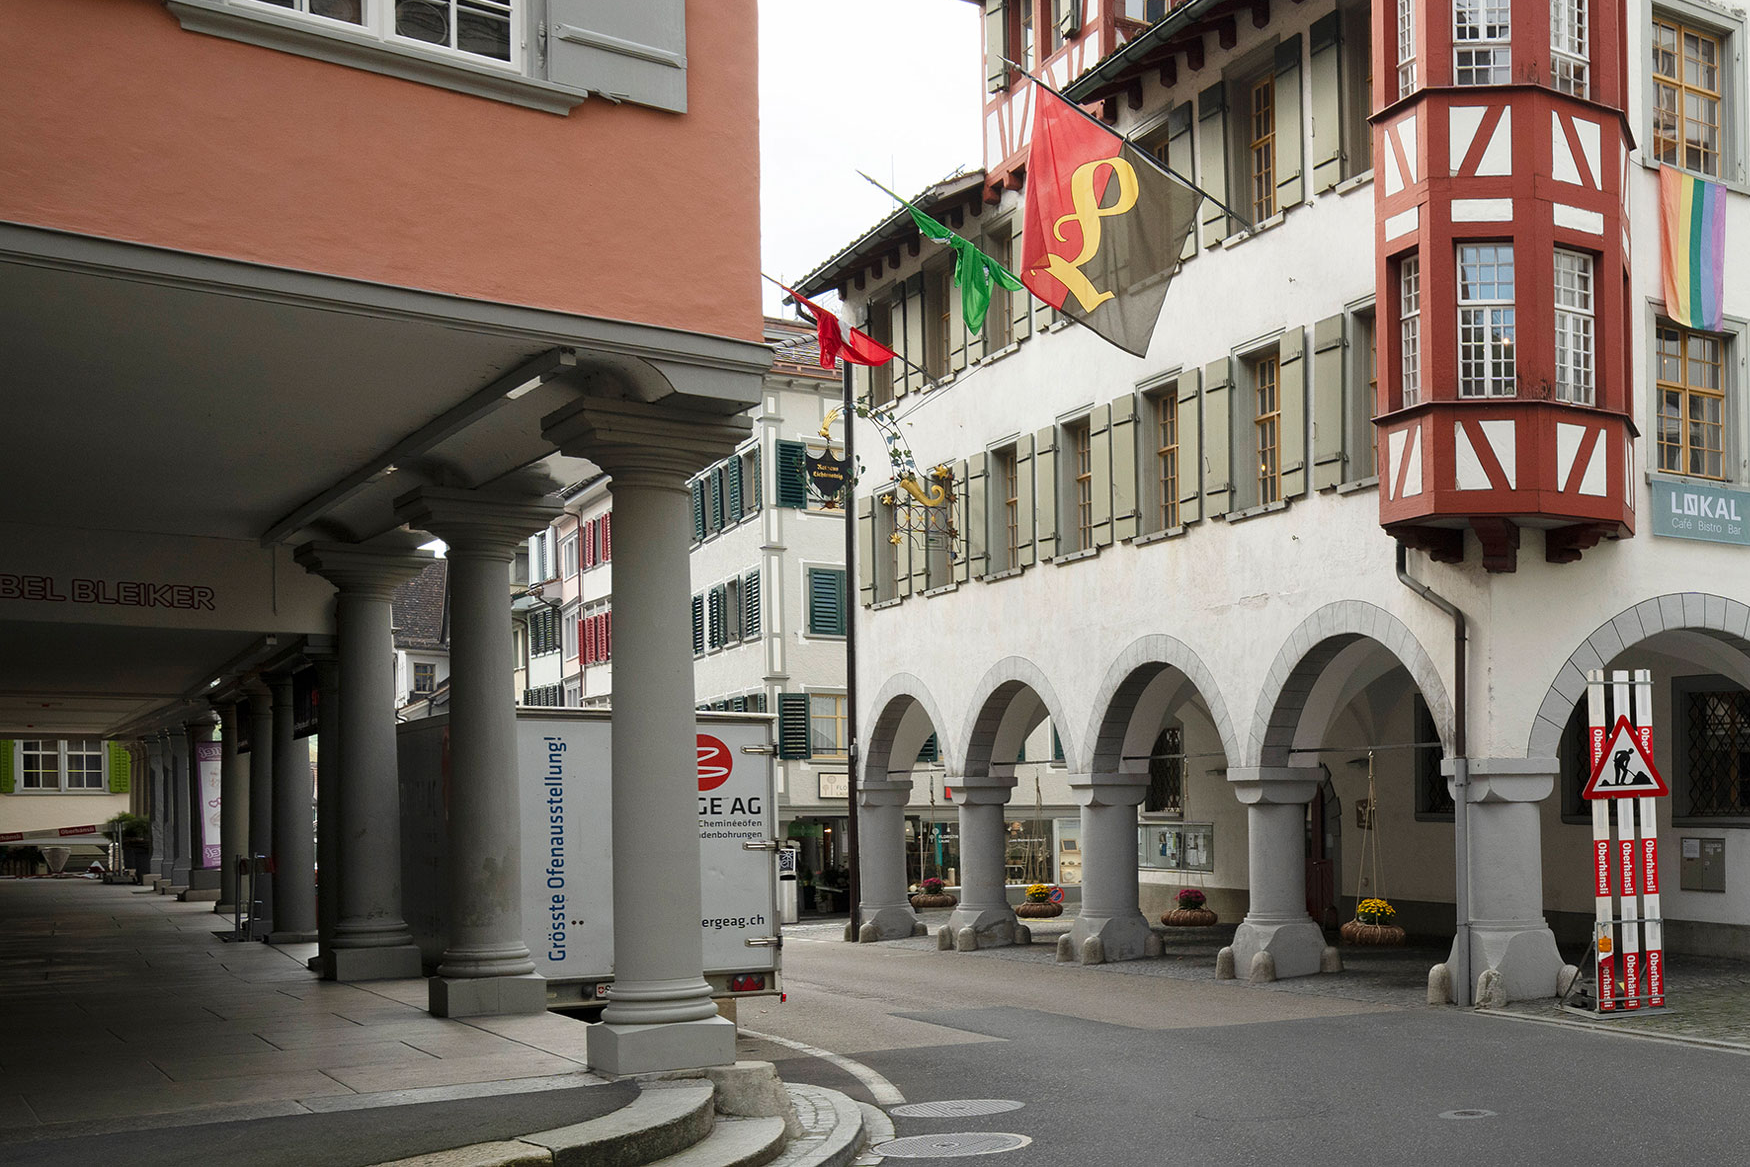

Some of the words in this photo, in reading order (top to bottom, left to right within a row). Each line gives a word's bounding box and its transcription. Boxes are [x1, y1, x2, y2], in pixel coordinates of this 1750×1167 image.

[1671, 517, 1692, 530] Café
[1698, 520, 1722, 533] Bistro
[1728, 523, 1742, 535] Bar
[71, 578, 216, 611] BLEIKER
[543, 736, 567, 889] Ofenausstellung!
[730, 797, 761, 815] AG
[1598, 842, 1609, 895] Oberhänsli
[1622, 842, 1634, 895] Oberhänsli
[1645, 840, 1656, 892] Oberhänsli
[548, 894, 566, 961] Grösste
